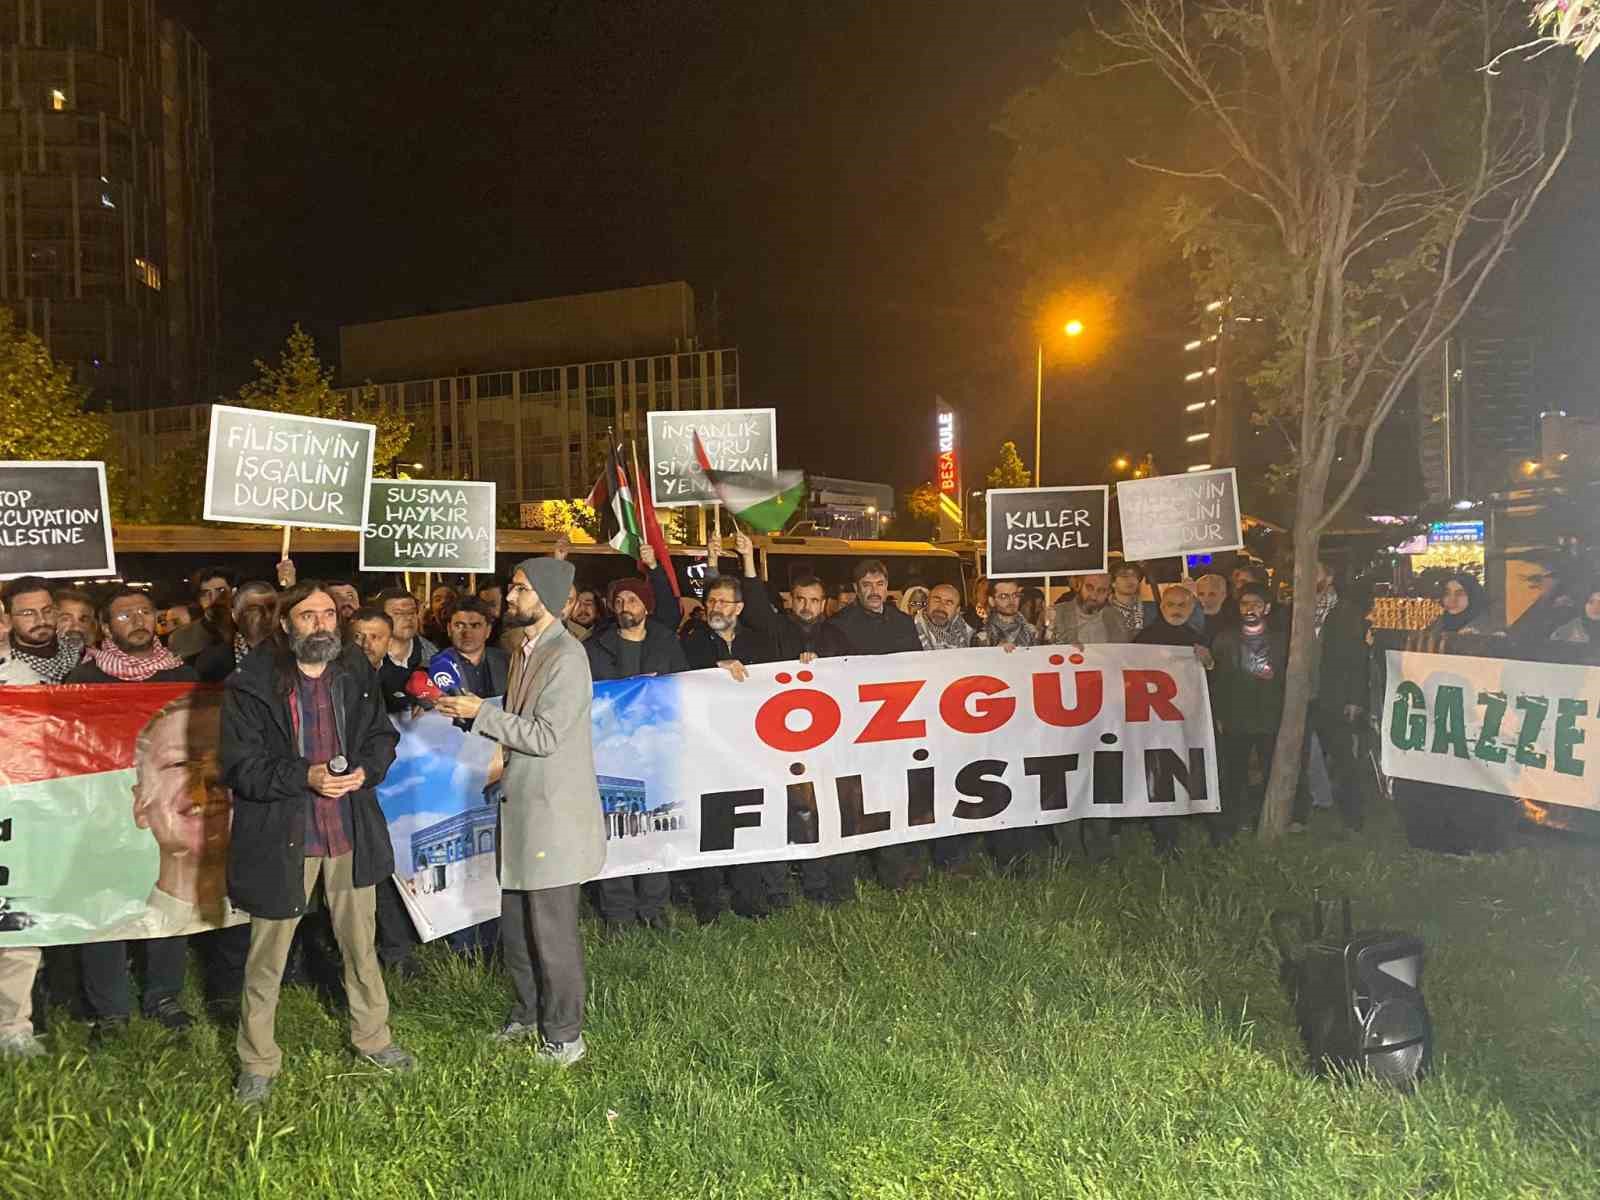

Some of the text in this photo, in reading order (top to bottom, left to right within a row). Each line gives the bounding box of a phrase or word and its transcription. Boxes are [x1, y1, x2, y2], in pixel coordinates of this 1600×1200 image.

[661, 419, 761, 440] İNSANLIK
[228, 423, 360, 459] FİLİSTİN'İN
[235, 451, 349, 487] İŞGALİNİ
[234, 483, 344, 515] DURDUR
[387, 488, 468, 505] SUSMA
[0, 509, 99, 527] CUPATION
[385, 505, 468, 523] HAYKIR
[1005, 509, 1091, 530] KILLER
[0, 528, 85, 546] LESTINE
[365, 523, 489, 541] SOYKIRIMA
[1006, 530, 1090, 551] ISRAEL
[394, 541, 460, 558] HAYIR
[755, 653, 1185, 752] ÖZGÜR
[1390, 680, 1600, 777] GAZZE
[699, 732, 1208, 853] FİLİSTİN
